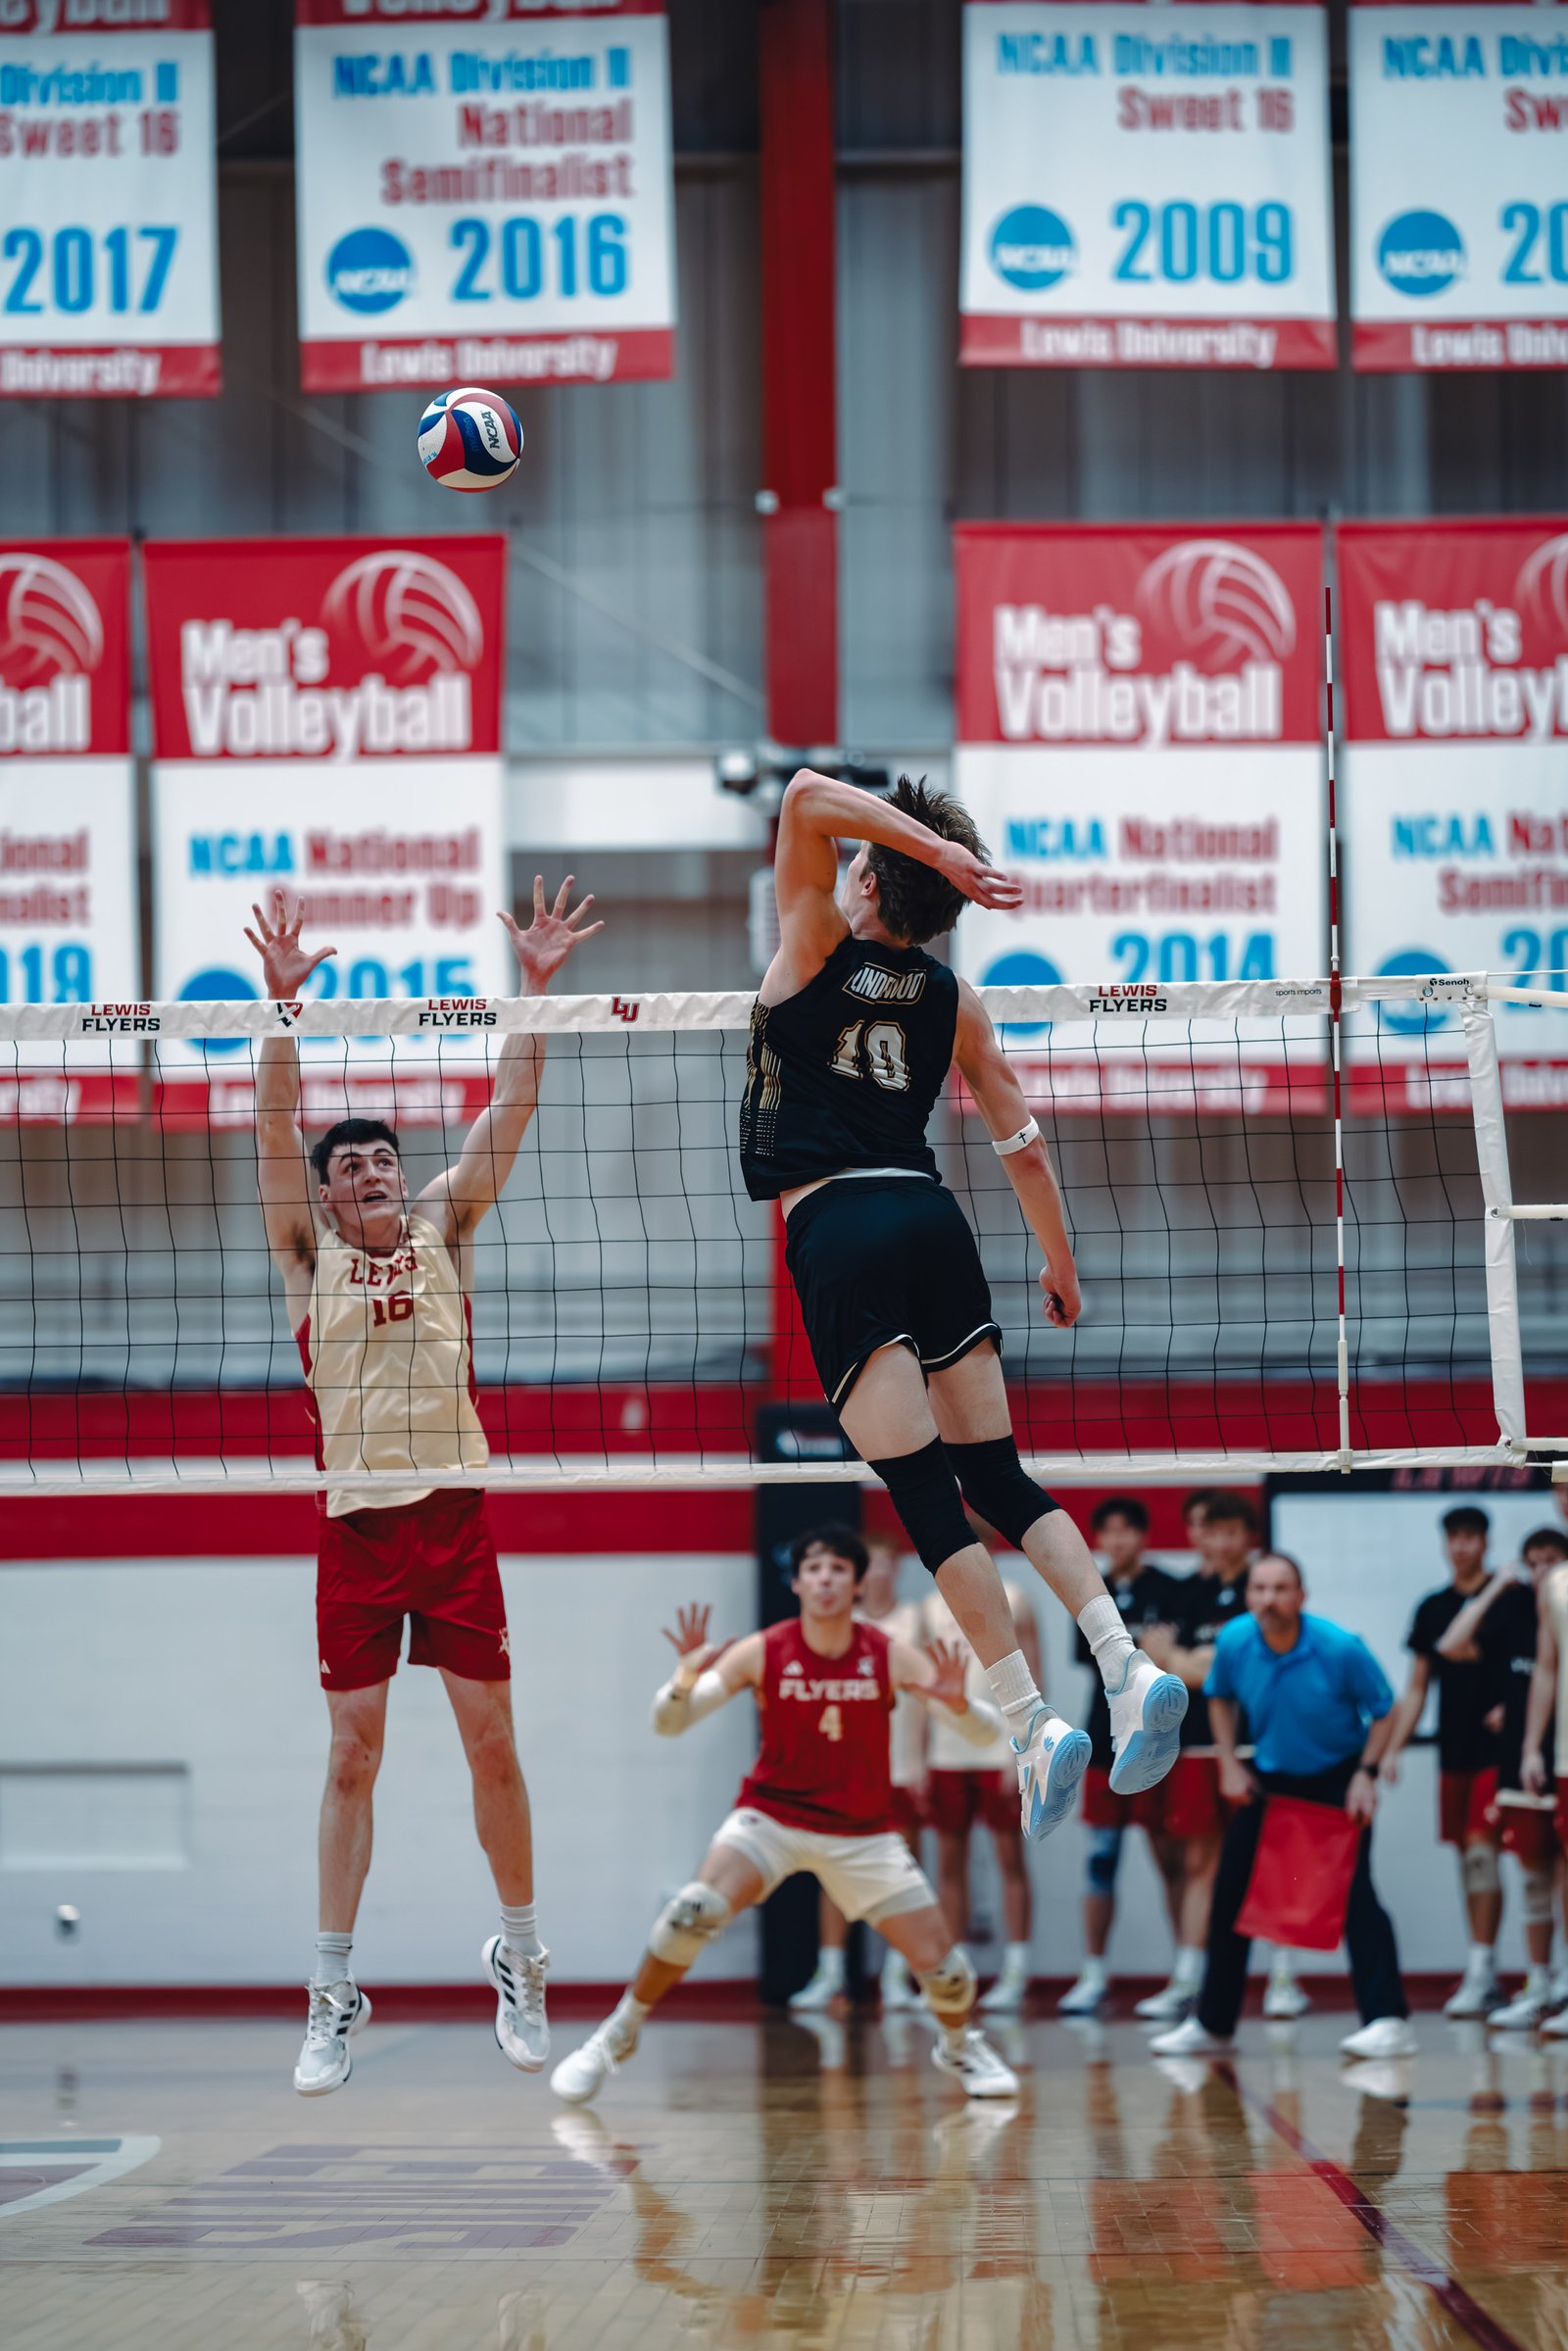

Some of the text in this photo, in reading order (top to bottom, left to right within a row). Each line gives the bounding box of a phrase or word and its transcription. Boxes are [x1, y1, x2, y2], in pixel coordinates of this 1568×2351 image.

[334, 52, 435, 96] NCAA
[451, 49, 594, 93] Division
[997, 32, 1099, 75] NCAA
[1113, 32, 1258, 76] Division
[1384, 34, 1485, 79] NCAA
[458, 99, 633, 148] National
[1117, 84, 1295, 132] Sweet 16
[140, 109, 179, 157] 16
[381, 154, 632, 206] Semifinalist
[450, 215, 628, 300] 2016
[1113, 200, 1294, 283] 2009
[3, 225, 178, 314] 2017
[360, 337, 619, 384] Lewis University
[1020, 318, 1277, 368] Lewis University
[1410, 322, 1504, 367] Lewis
[480, 411, 501, 450] NCAA
[181, 618, 329, 684] Men's
[994, 602, 1143, 669] Men's
[1374, 598, 1522, 664] Men's
[182, 671, 472, 762] Volleyball
[996, 661, 1283, 749] Volleyball
[188, 826, 478, 876] NCAA National
[1004, 815, 1279, 862] NCAA National
[1392, 813, 1495, 860] NCAA
[426, 880, 481, 930] Up
[1112, 931, 1278, 983] 2014
[90, 1004, 151, 1016] LEWIS
[428, 998, 487, 1010] LEWIS
[611, 996, 640, 1023] LU
[1089, 999, 1168, 1012] FLYERS
[1098, 984, 1158, 998] LEWIS
[81, 1017, 161, 1032] FLYERS
[418, 1012, 498, 1026] FLYERS
[827, 1019, 911, 1091] 10
[1104, 1064, 1268, 1114] University
[350, 1248, 418, 1287] LEWS
[371, 1290, 413, 1327] 16
[778, 1678, 880, 1701] FLYERS
[818, 1704, 843, 1741] 4
